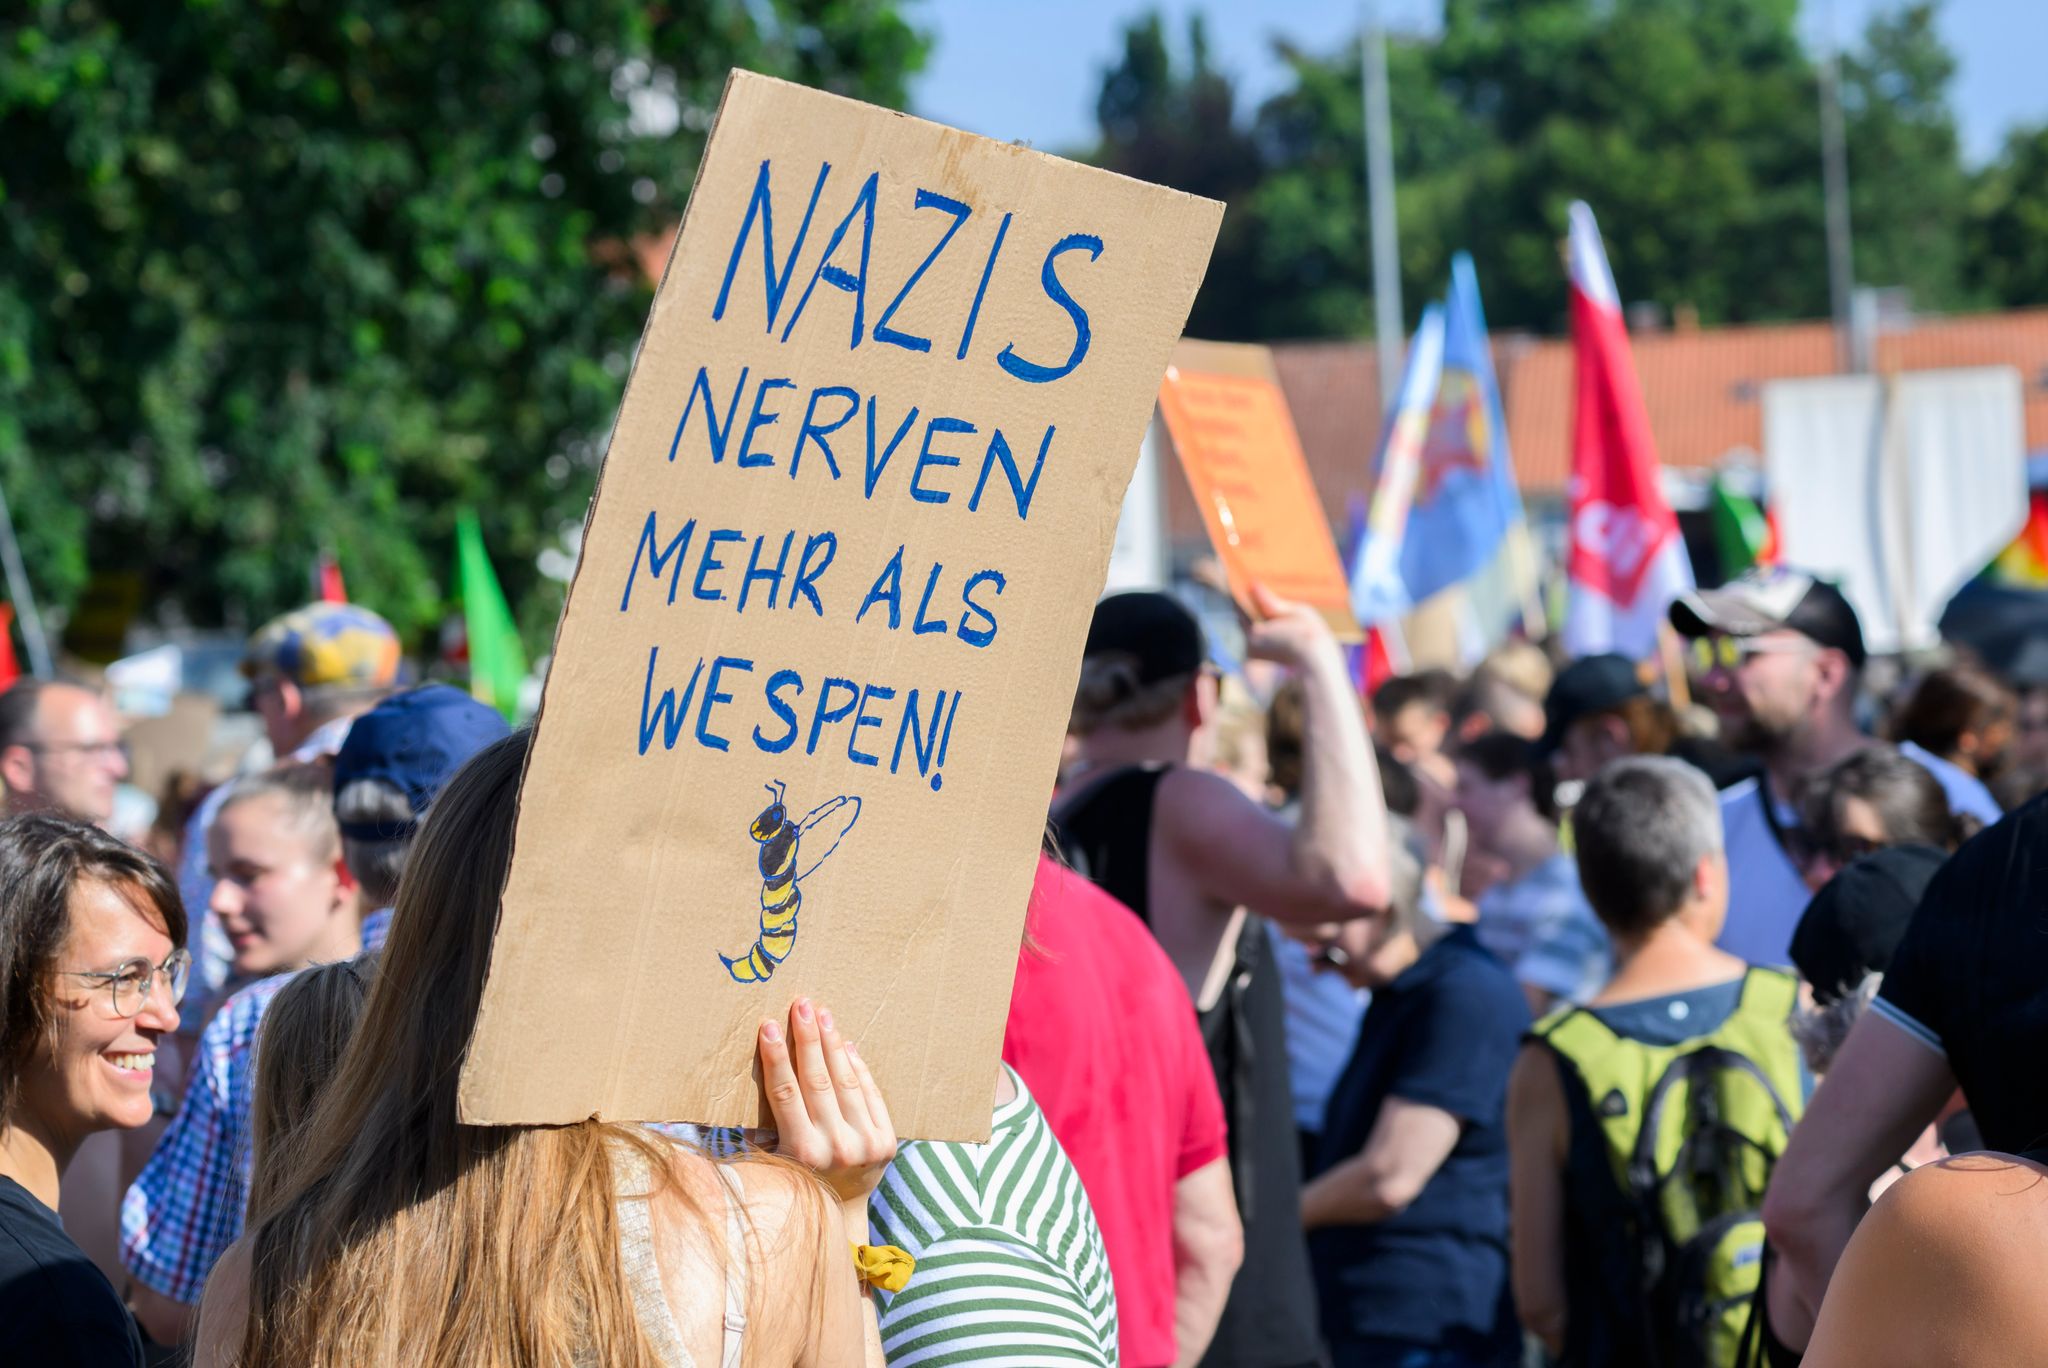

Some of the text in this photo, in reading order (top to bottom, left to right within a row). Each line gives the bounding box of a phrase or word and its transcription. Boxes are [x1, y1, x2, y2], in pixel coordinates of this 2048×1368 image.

[712, 159, 1104, 384] NAZIS
[668, 367, 1056, 521] NERVEN
[620, 511, 1007, 649] MEHR ALS
[638, 647, 963, 792] WESPEN!
